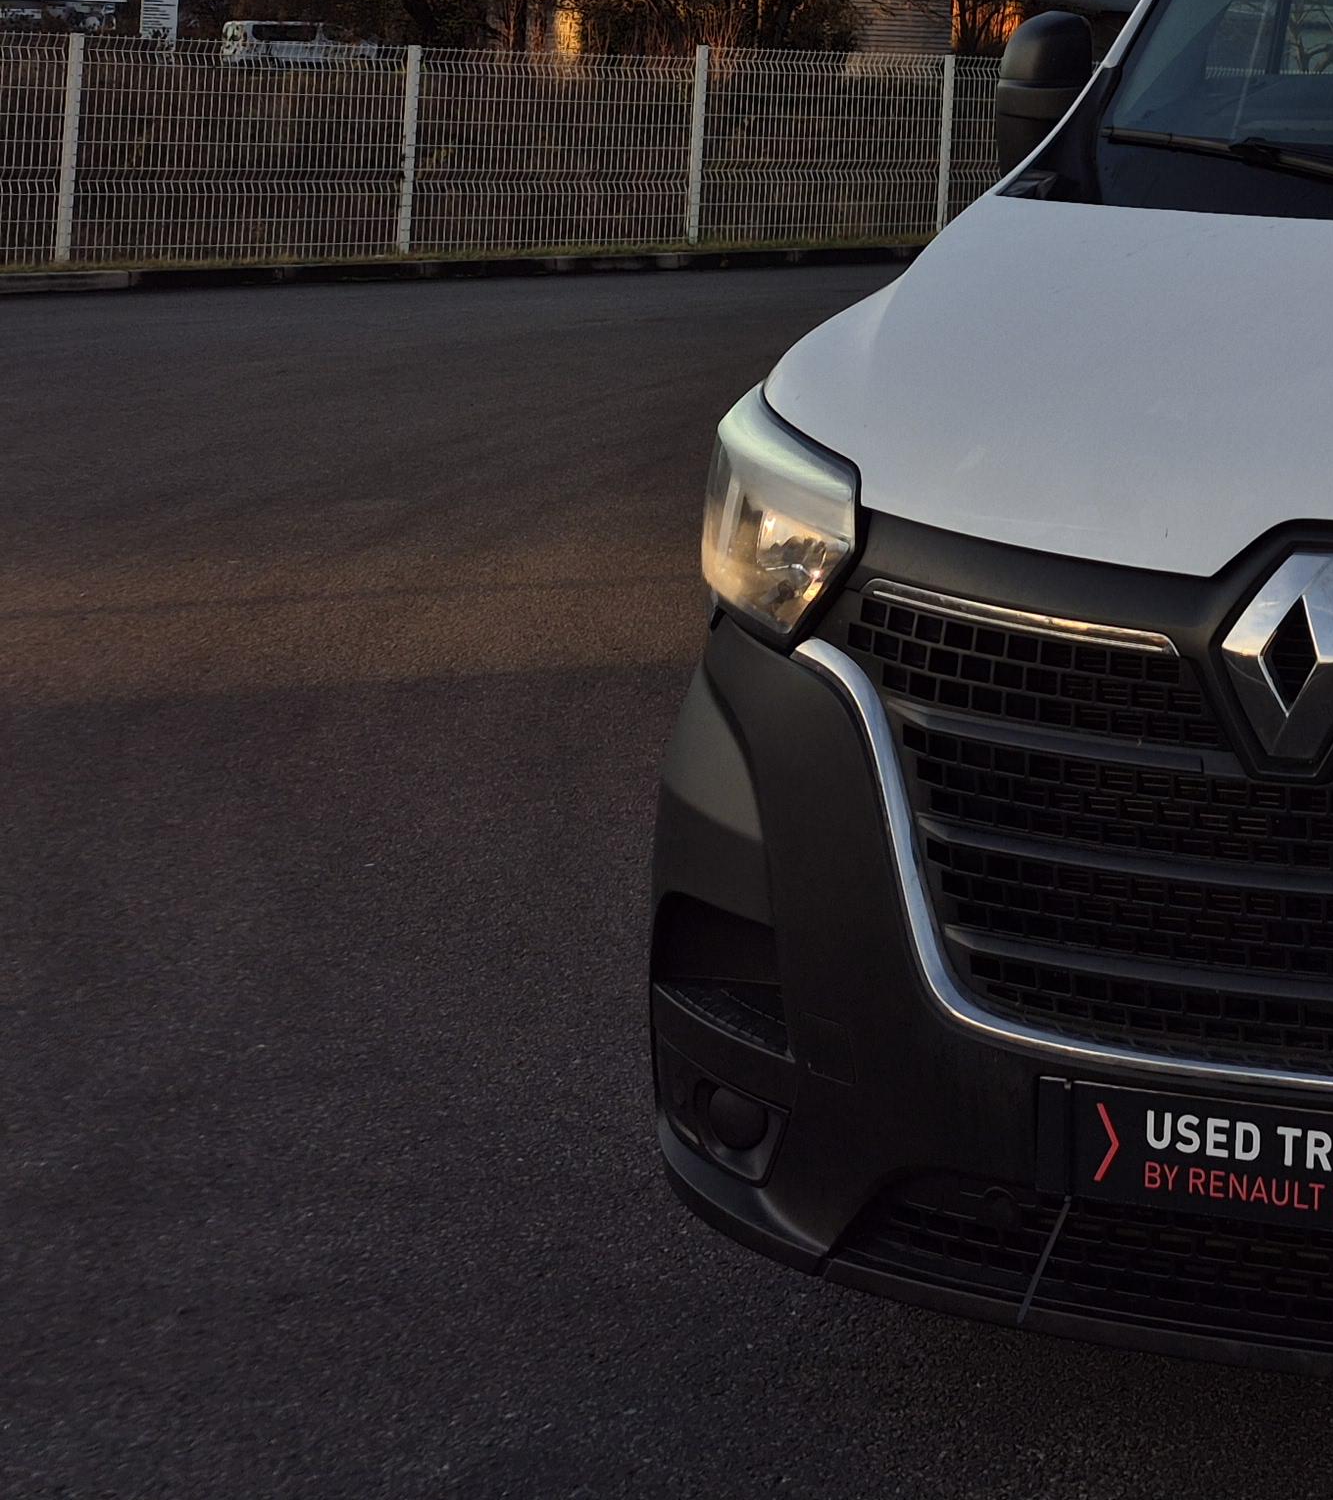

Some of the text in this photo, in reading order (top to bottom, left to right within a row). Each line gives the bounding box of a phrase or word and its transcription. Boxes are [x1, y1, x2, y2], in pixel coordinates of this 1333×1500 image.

[1146, 1109, 1261, 1161] USED
[1144, 1161, 1179, 1190] BY
[1188, 1167, 1325, 1210] RENAULT
